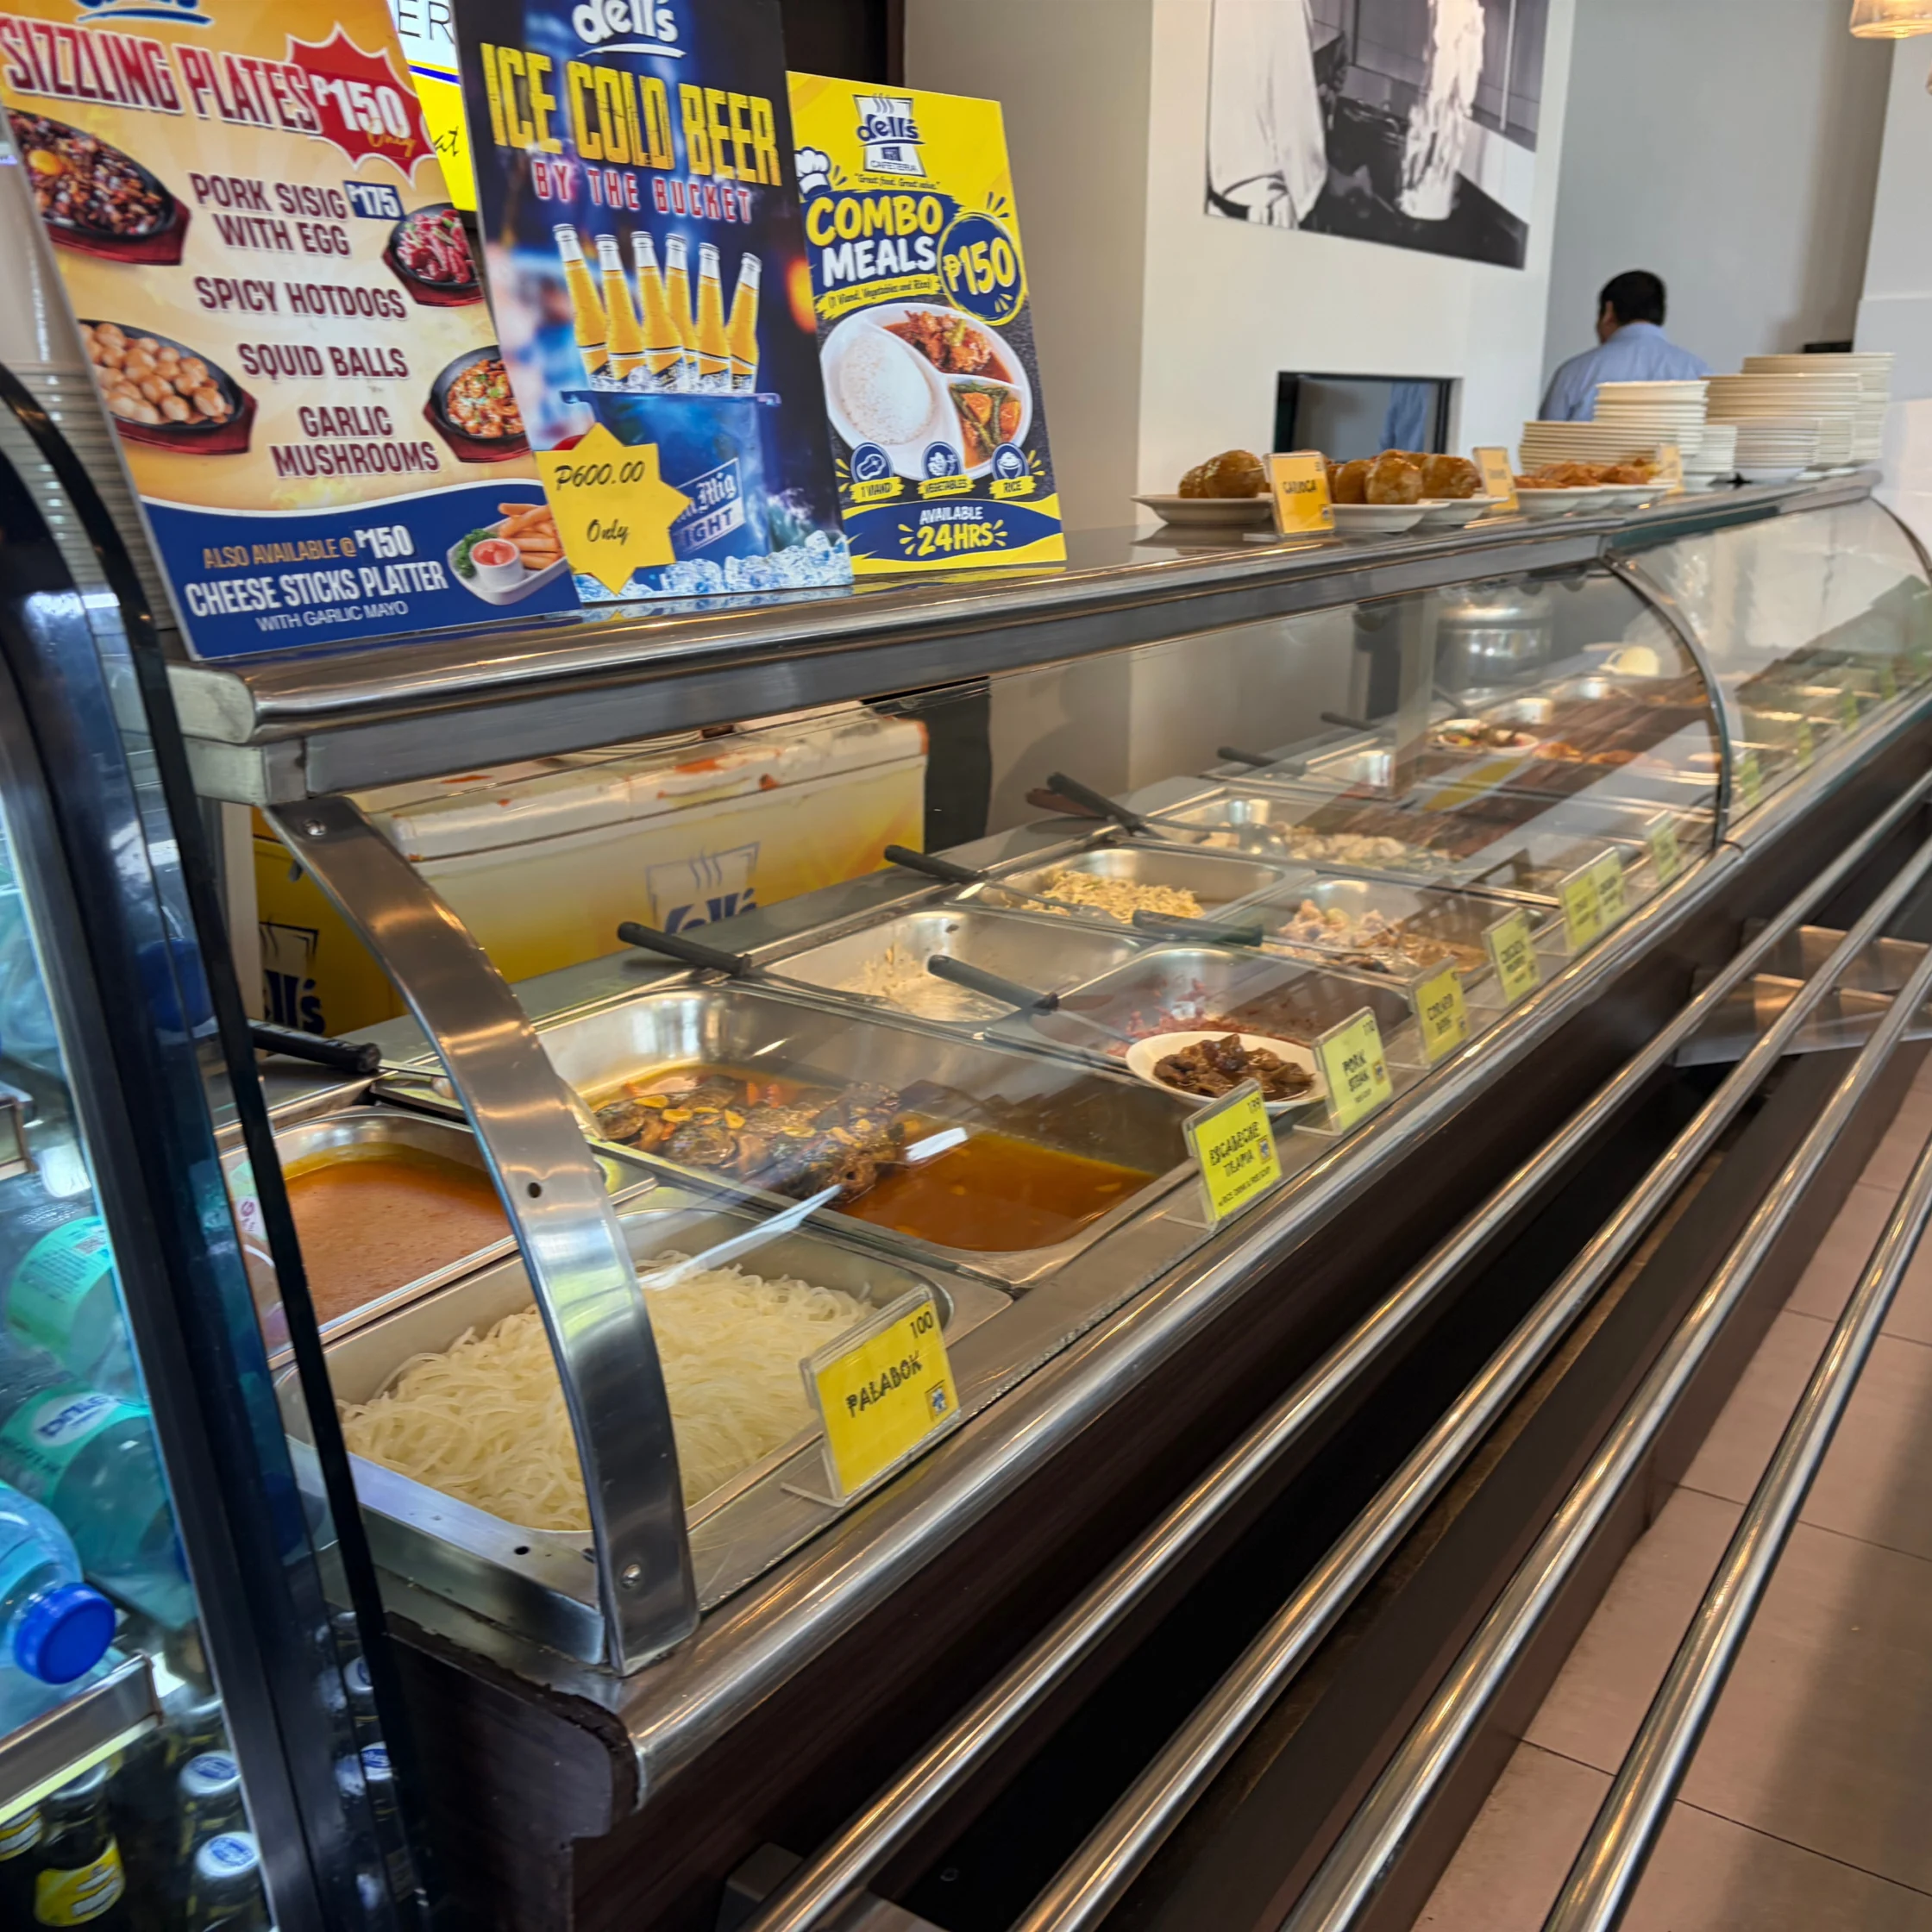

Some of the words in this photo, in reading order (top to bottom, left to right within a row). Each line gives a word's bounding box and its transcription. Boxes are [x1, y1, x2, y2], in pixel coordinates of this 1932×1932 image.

[0, 16, 182, 113] SIZZLING
[175, 45, 321, 133] PLATES
[481, 42, 562, 154] ICE
[567, 60, 674, 170] COLD
[679, 83, 781, 186] BEER
[856, 113, 919, 141] dell's
[189, 173, 273, 212] PORK
[274, 182, 348, 219] SISIG
[533, 160, 573, 202] BY
[587, 167, 641, 210] THE
[653, 178, 751, 223] BUCKET
[212, 212, 294, 254] WITH
[300, 221, 351, 256] EGG
[806, 195, 944, 247] COMBO
[822, 235, 937, 287] MEALS
[194, 276, 278, 312] SPICY
[290, 282, 407, 319] HOTDOGS
[238, 342, 323, 381] SQUID
[330, 346, 409, 379] BALLS
[298, 405, 393, 438] GARLIC
[270, 441, 441, 478] MUSHROOMS
[696, 472, 737, 512] Mig
[925, 479, 968, 493] VEGETABLES
[1003, 481, 1022, 492] RICE
[586, 519, 630, 546] Only
[683, 507, 733, 547] IGHT
[919, 505, 983, 524] AVAILABLE
[203, 544, 249, 569] ALSO
[253, 538, 338, 564] AVAILABLE
[917, 522, 994, 556] 24HRS
[185, 575, 280, 618] CHEESE
[279, 568, 358, 607] STICKS
[362, 560, 449, 597] PLATTER
[254, 613, 302, 632] WITH
[304, 606, 363, 628] GARLIC
[365, 599, 409, 620] MAYO
[1342, 1048, 1367, 1076] PORK
[1208, 1121, 1261, 1166] ESCABECHE
[909, 1310, 933, 1339] 100
[845, 1351, 923, 1419] PALABOK
